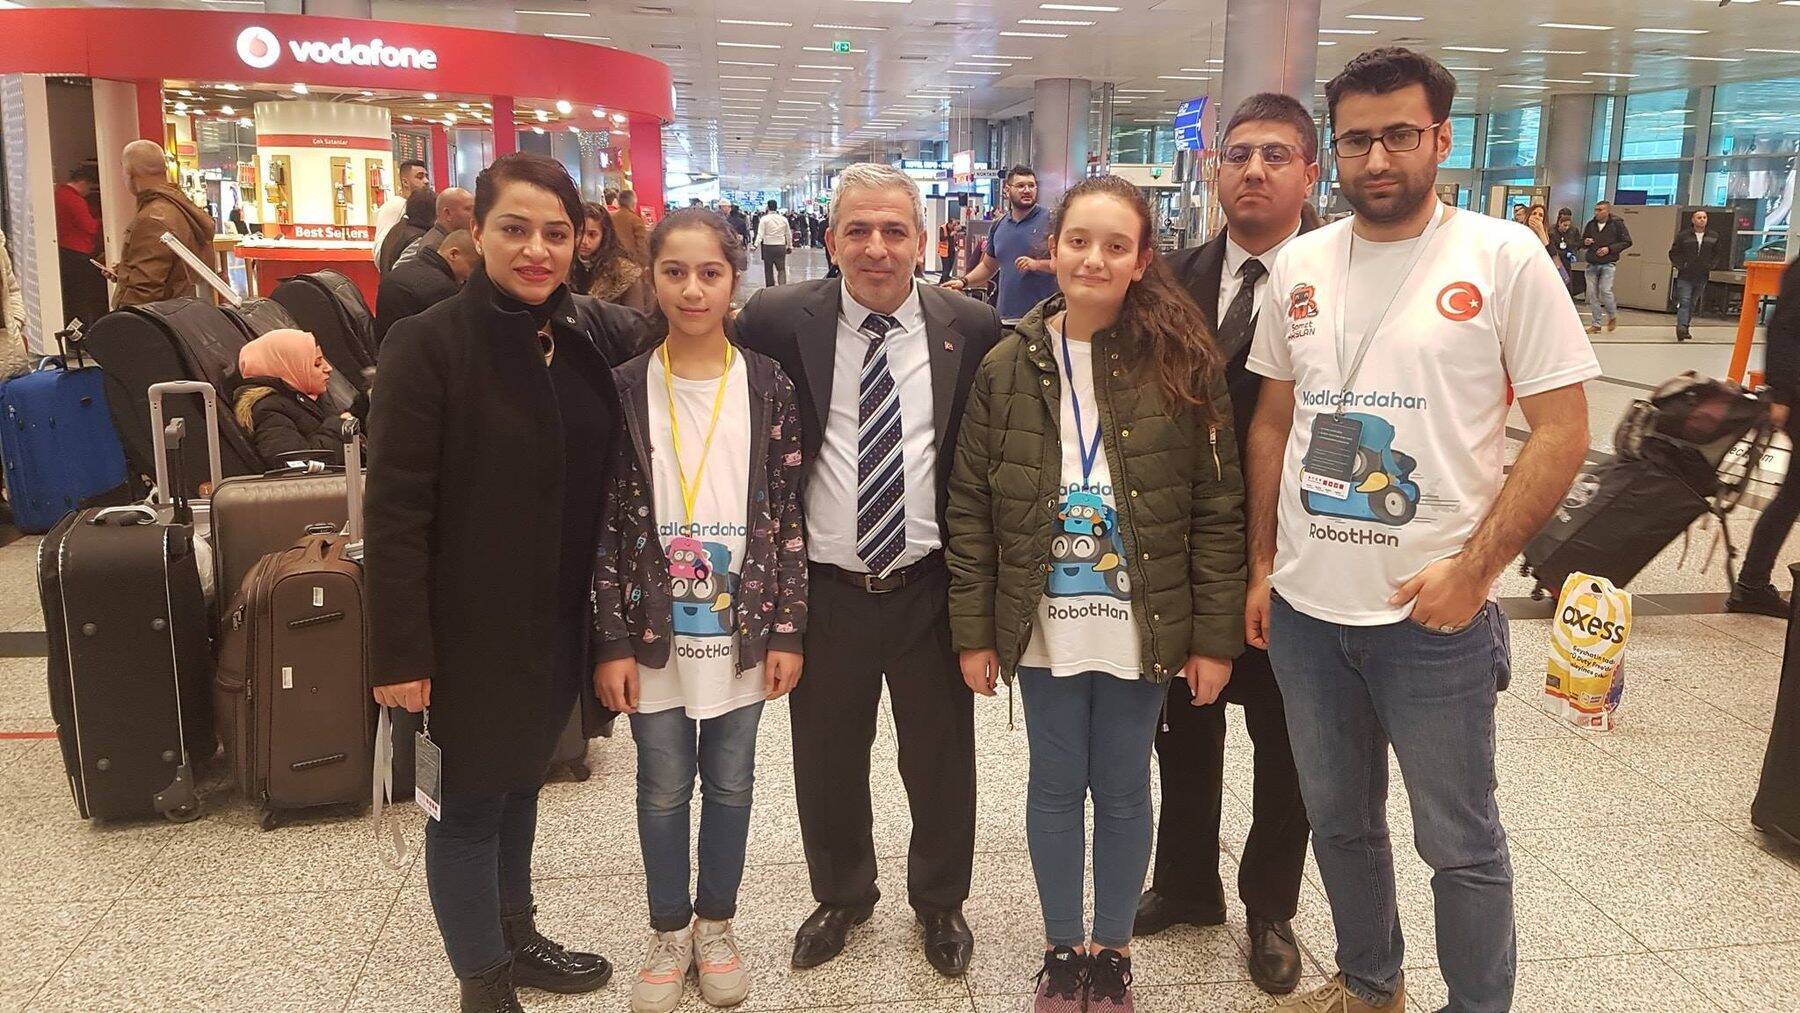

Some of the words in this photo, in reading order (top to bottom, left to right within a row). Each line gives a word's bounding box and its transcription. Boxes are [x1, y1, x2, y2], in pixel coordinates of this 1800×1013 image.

[289, 37, 437, 69] vodafone
[295, 226, 324, 239] Best
[325, 227, 369, 240] Sellers
[1309, 523, 1399, 547] RobotHan
[1048, 603, 1129, 621] RobotHan
[1562, 605, 1625, 644] axess
[677, 643, 732, 659] obotHa
[1576, 655, 1591, 667] Duty
